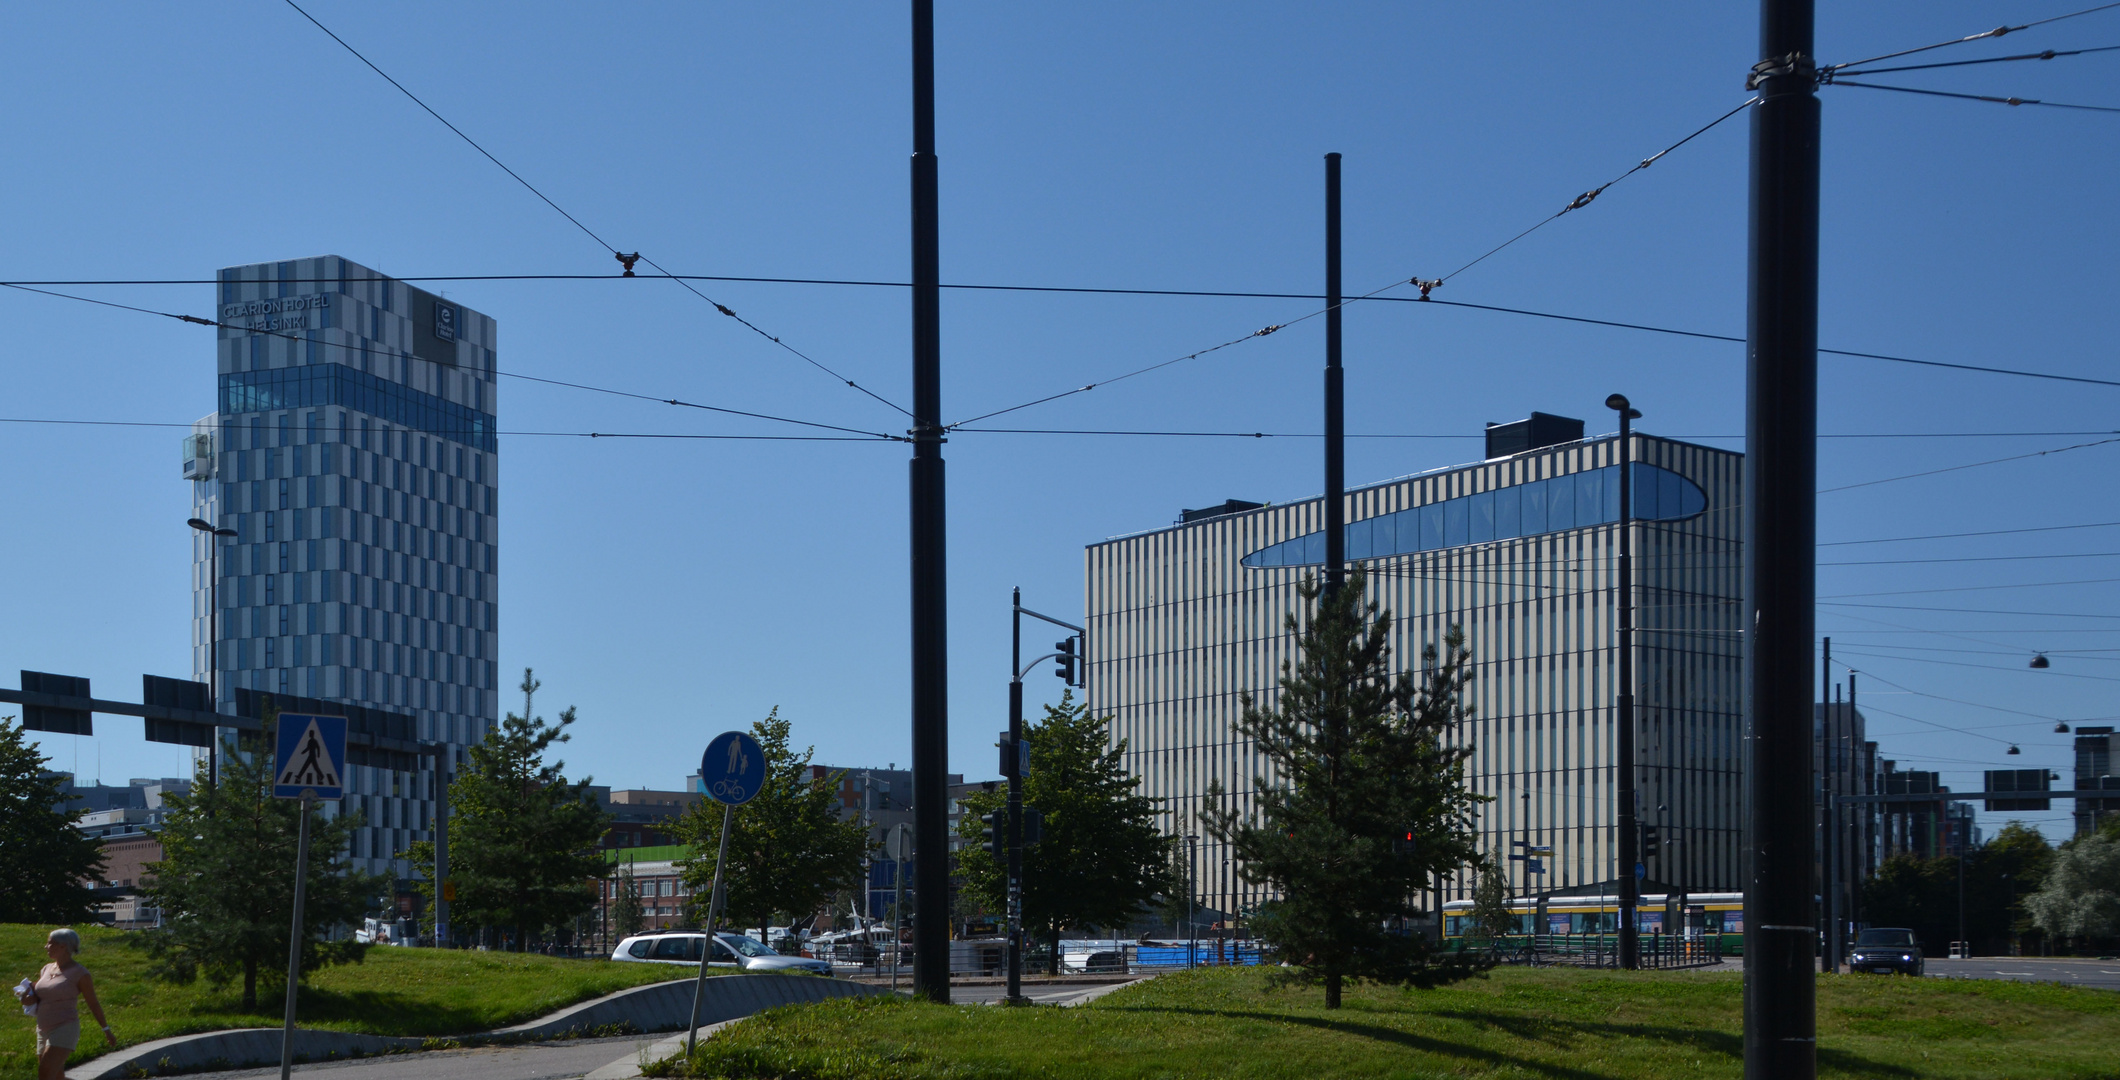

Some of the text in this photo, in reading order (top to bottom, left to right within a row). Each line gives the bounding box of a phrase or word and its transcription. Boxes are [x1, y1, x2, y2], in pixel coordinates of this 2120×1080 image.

[223, 295, 329, 318] CLARION HOTEL
[246, 316, 306, 333] HELSINKI
